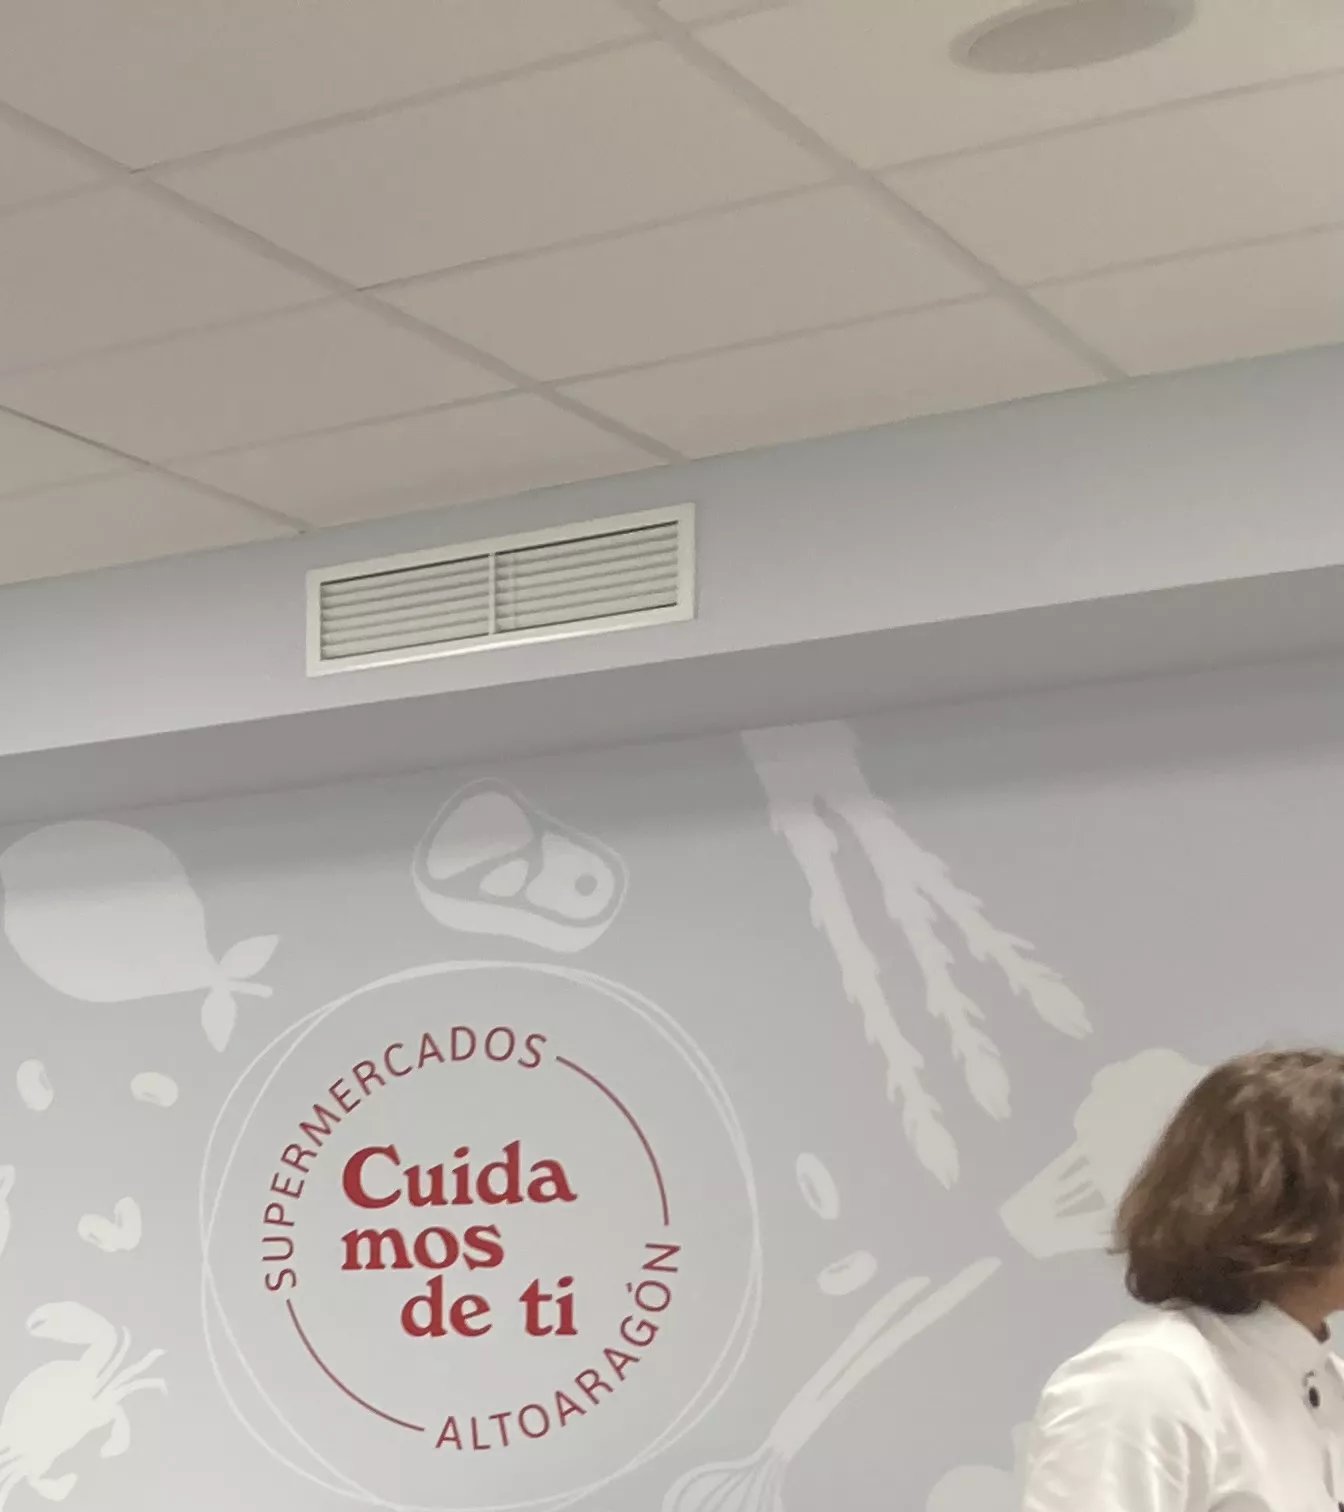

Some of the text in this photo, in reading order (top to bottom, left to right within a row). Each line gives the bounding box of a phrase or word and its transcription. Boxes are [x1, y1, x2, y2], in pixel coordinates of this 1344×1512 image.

[261, 1024, 548, 1293] SUPERMERCADOS
[340, 1138, 578, 1209] Cuida
[339, 1223, 505, 1272] mos
[399, 1273, 578, 1338] de ti
[434, 1241, 681, 1451] ALTOARAGÓN
